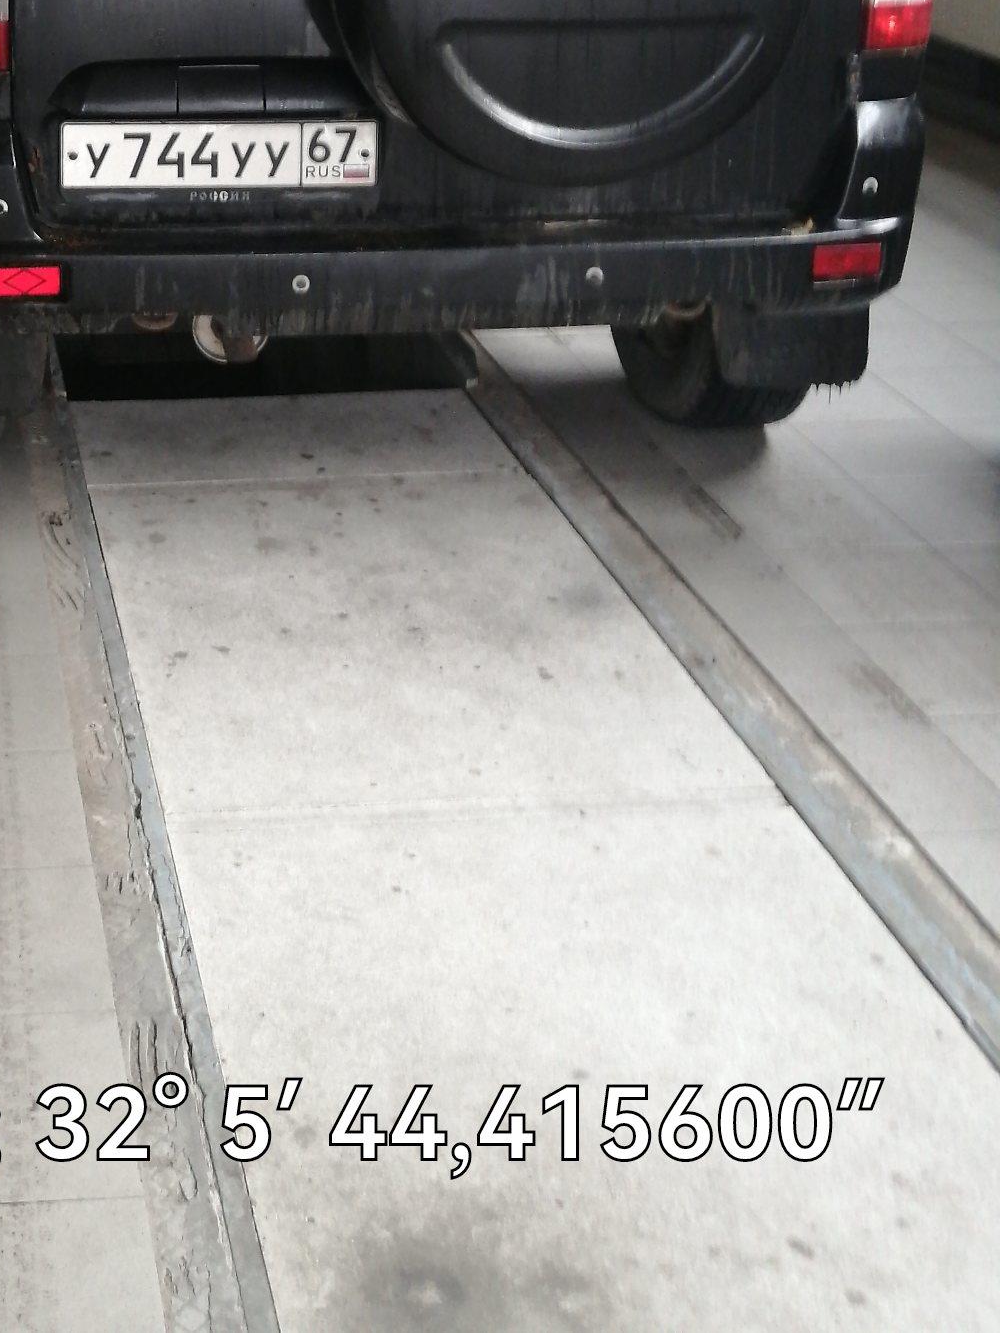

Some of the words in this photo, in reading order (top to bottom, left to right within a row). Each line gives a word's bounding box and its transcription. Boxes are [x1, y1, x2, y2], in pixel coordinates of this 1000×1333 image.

[87, 132, 290, 179] У744УУ
[308, 128, 357, 163] 67
[306, 165, 341, 178] RUS
